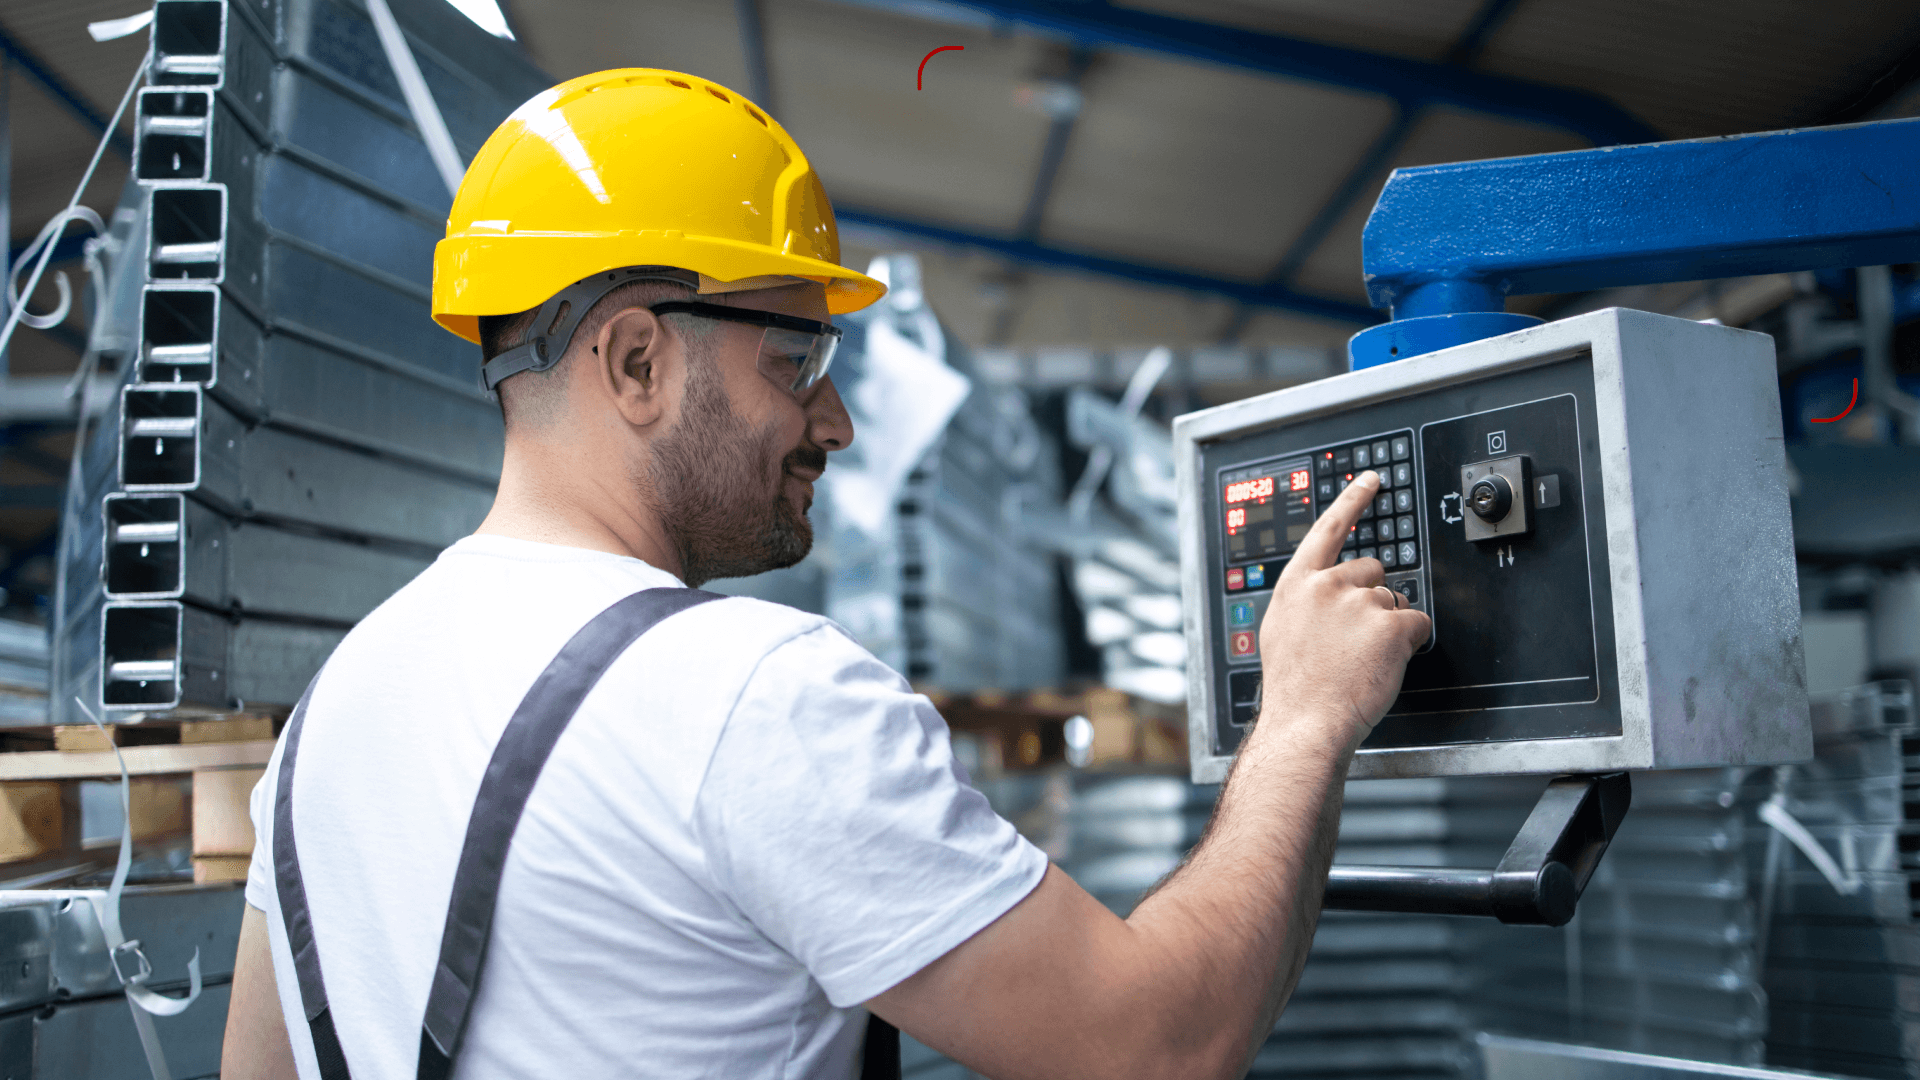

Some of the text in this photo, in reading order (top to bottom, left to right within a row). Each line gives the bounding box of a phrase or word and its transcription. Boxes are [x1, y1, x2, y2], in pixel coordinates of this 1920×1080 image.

[1377, 447, 1384, 458] 8
[1396, 443, 1403, 454] 9
[1358, 451, 1365, 462] 7
[1380, 472, 1386, 484] 5
[1398, 469, 1405, 480] 6
[1381, 499, 1387, 510] 2
[1400, 495, 1407, 506] 3
[1382, 524, 1389, 536] 0
[1384, 550, 1391, 562] C
